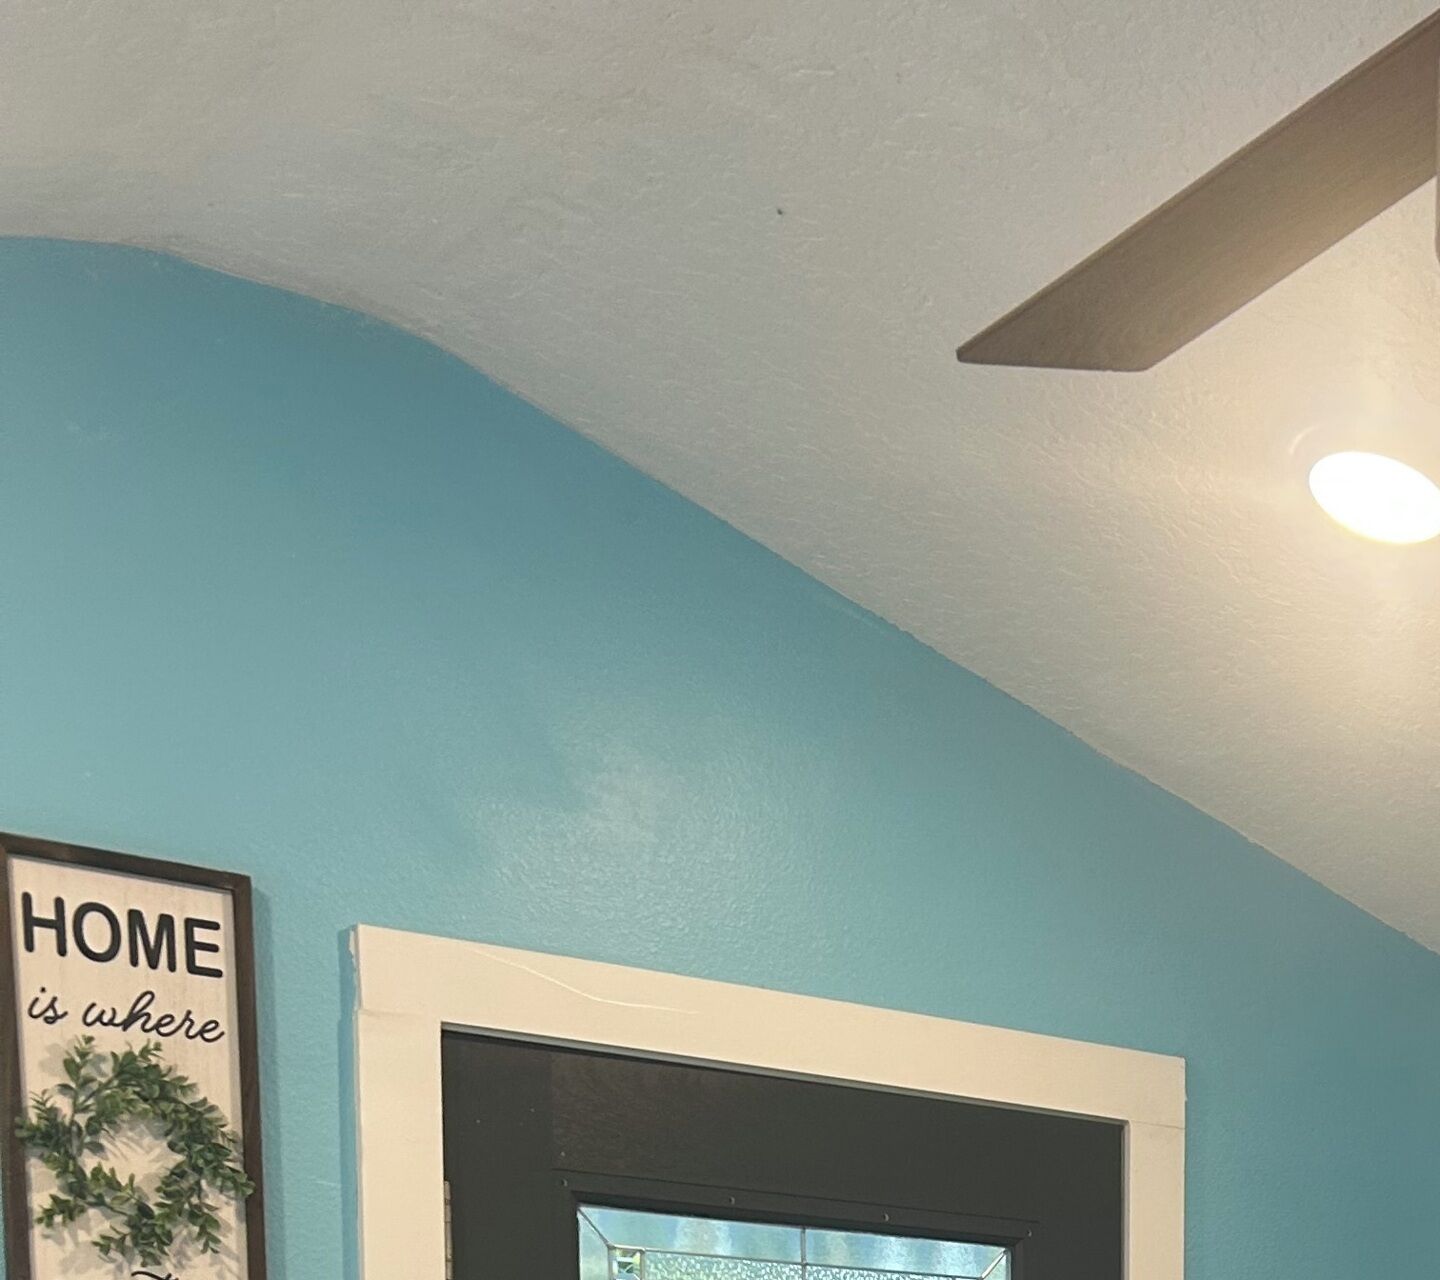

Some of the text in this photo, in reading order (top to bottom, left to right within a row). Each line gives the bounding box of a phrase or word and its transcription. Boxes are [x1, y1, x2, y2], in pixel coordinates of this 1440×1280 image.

[21, 891, 224, 979] HOME
[27, 986, 226, 1043] is where
